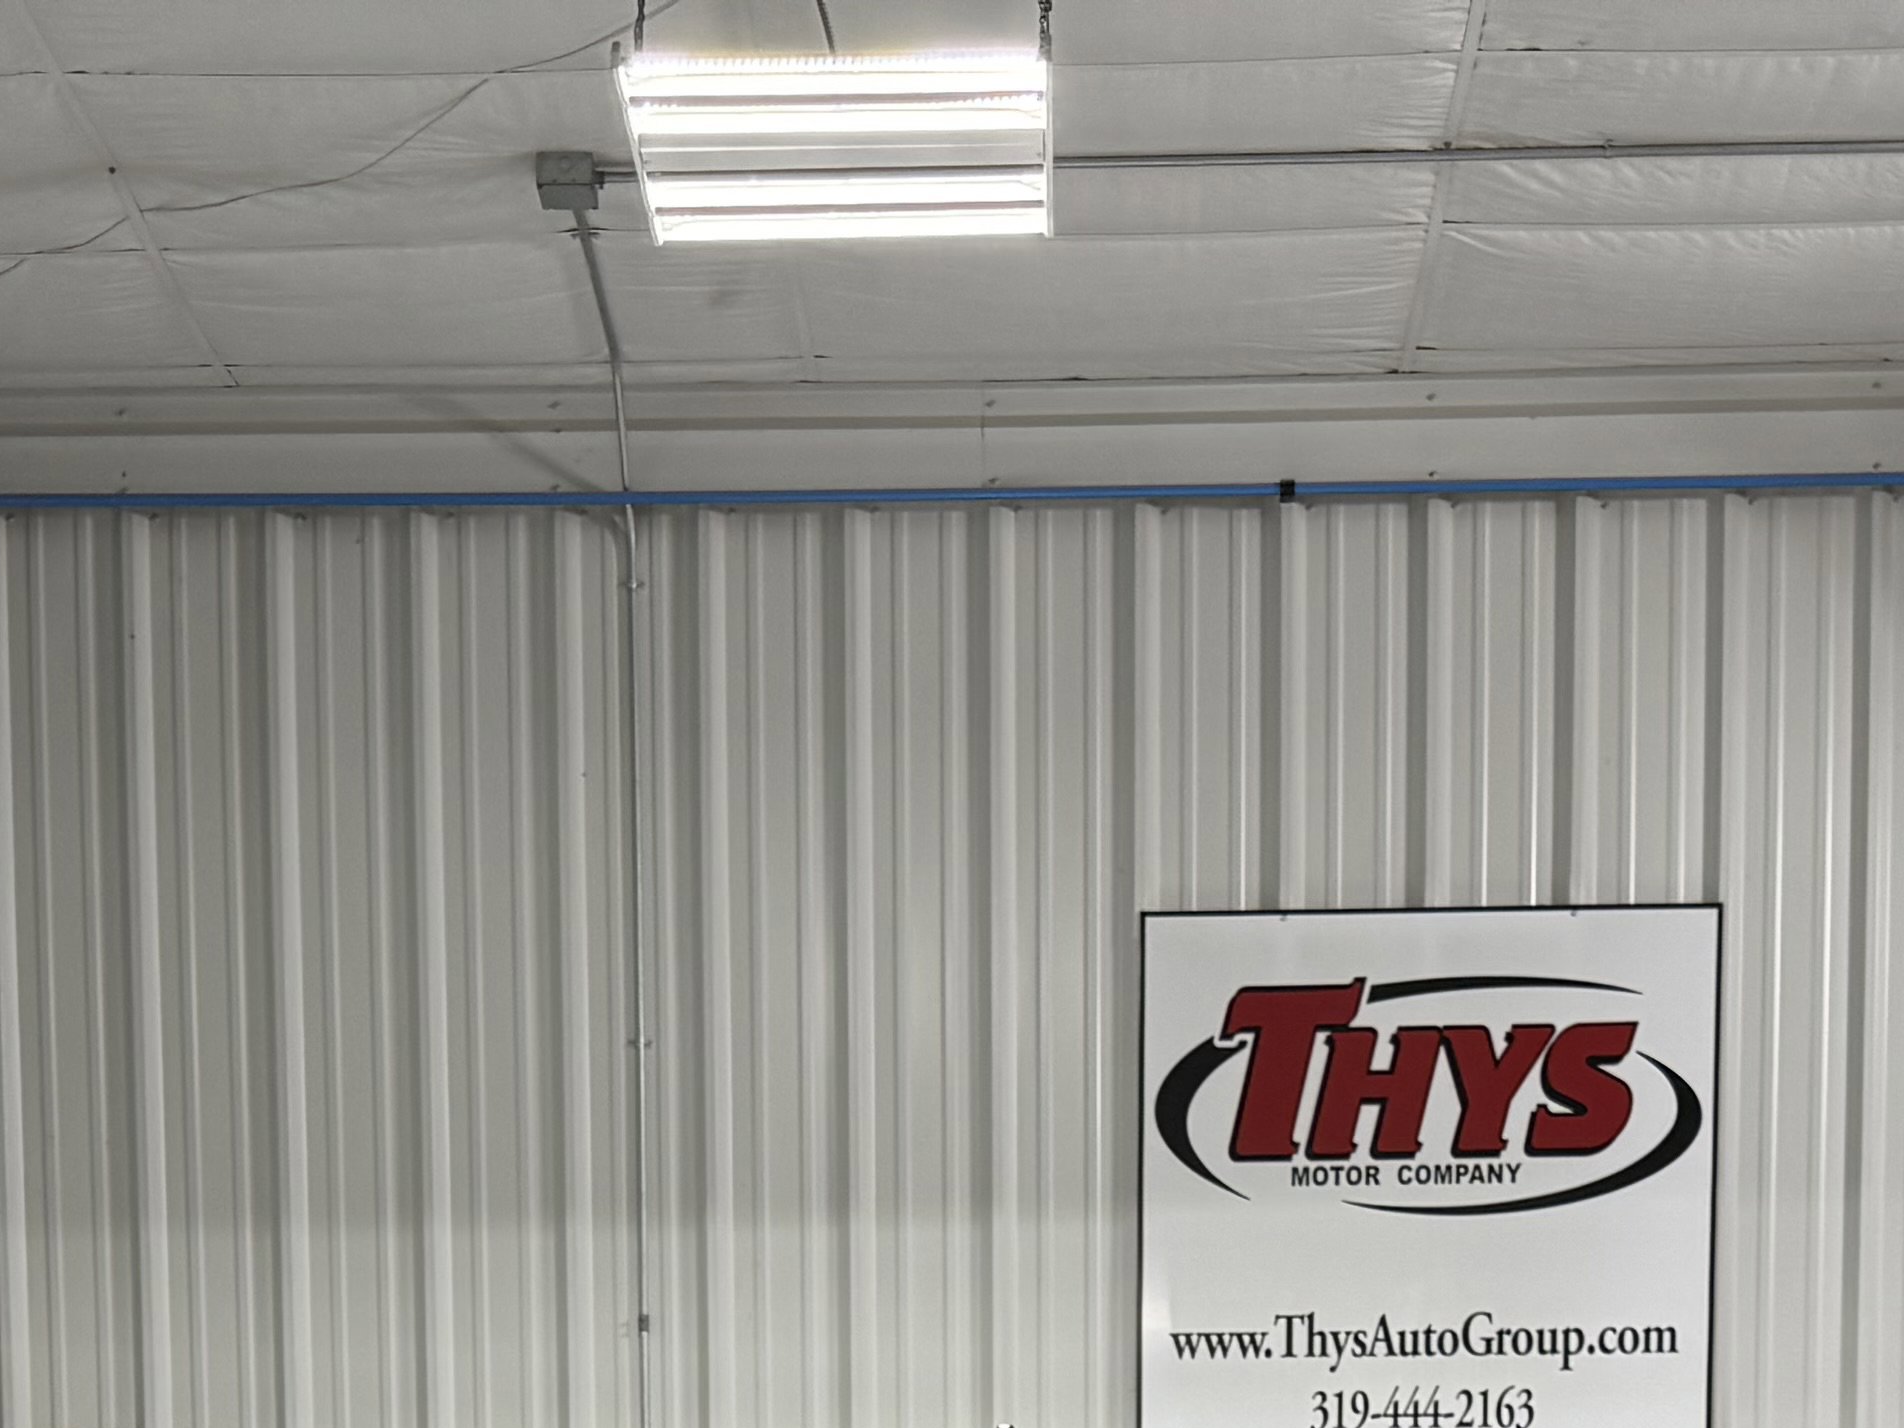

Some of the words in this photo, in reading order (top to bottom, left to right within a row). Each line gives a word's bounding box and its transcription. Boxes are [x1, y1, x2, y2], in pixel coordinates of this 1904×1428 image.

[1220, 976, 1639, 1162] THYS
[1291, 1165, 1381, 1187] MOTOR
[1397, 1163, 1522, 1185] COMPANY
[1170, 1312, 1679, 1371] www.ThysAutoGroup.com
